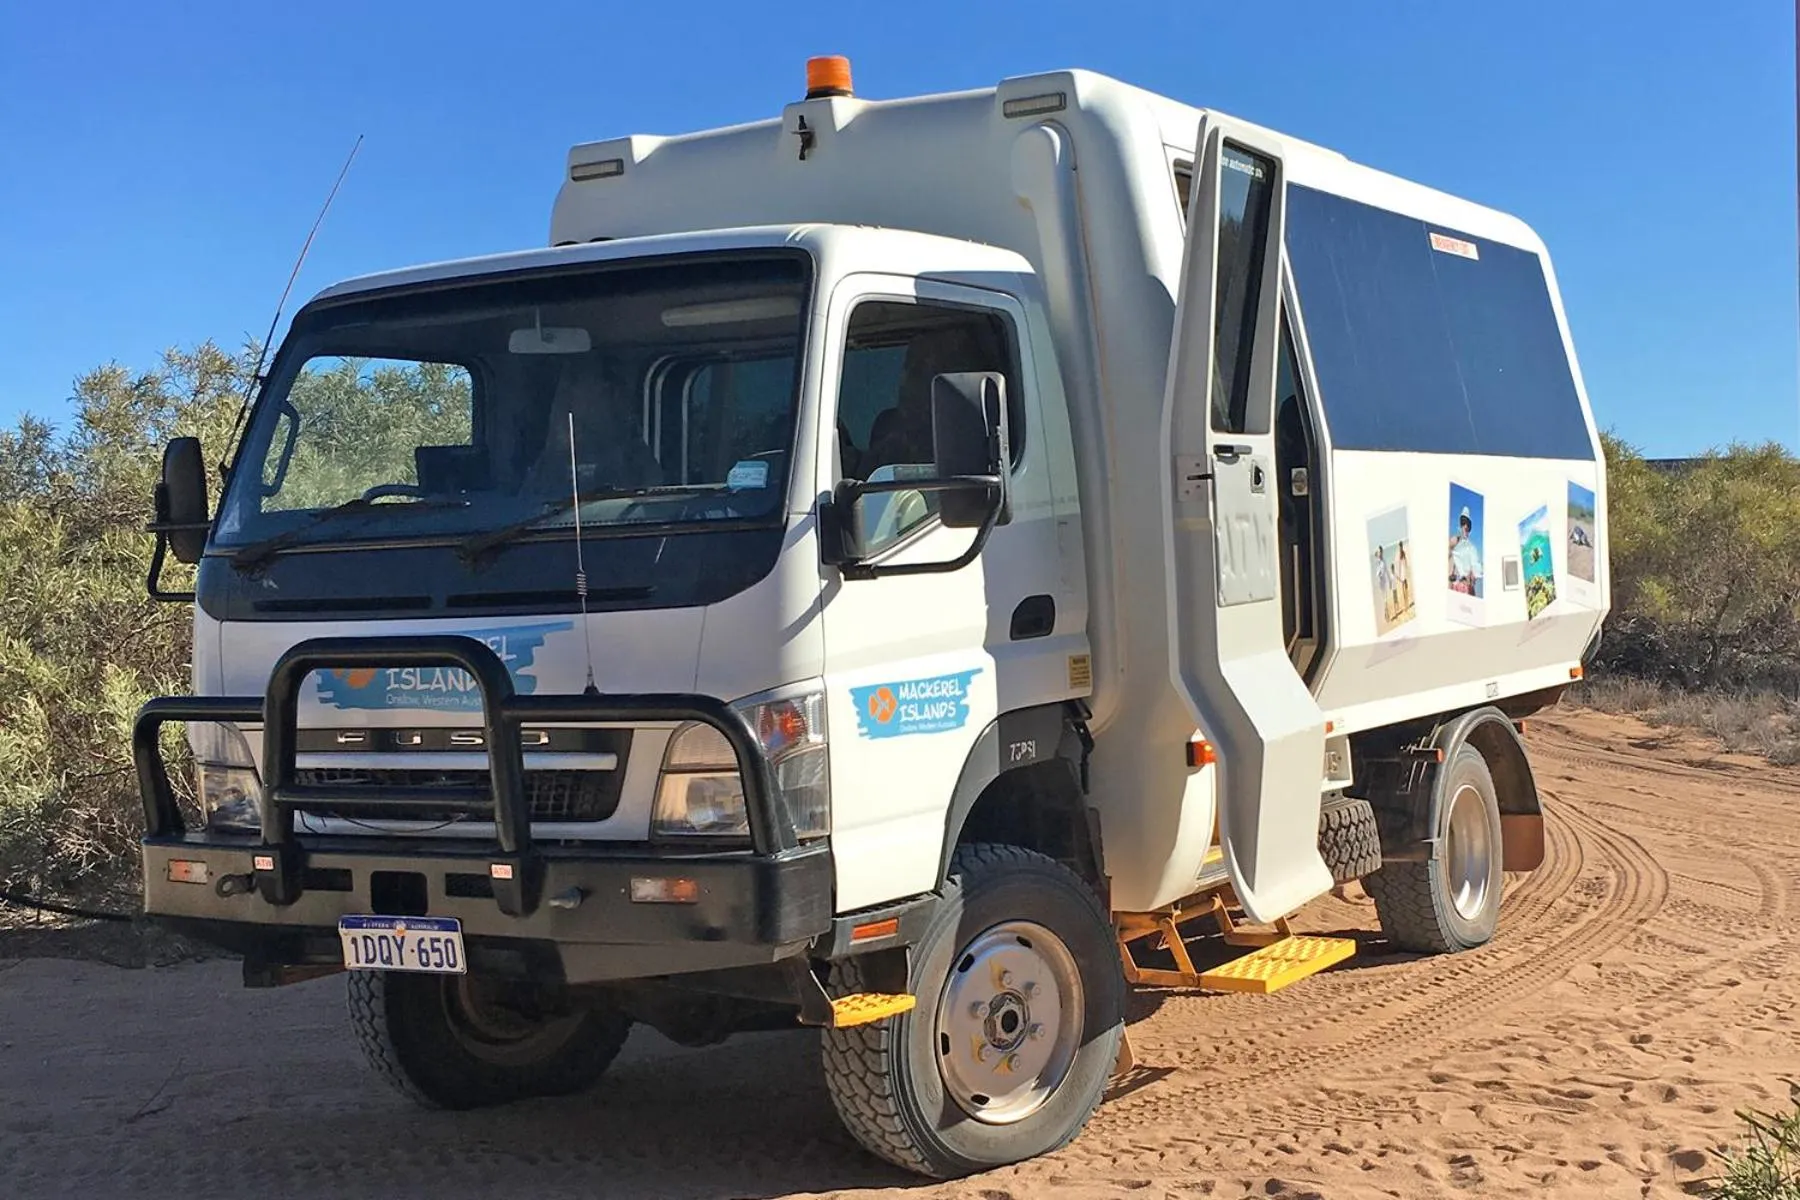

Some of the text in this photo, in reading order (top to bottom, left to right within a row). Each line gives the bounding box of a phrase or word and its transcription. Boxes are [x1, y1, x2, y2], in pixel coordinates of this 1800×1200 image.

[386, 668, 477, 692] ISLAND
[899, 679, 963, 700] MACKEREL
[900, 701, 956, 721] ISLANDS
